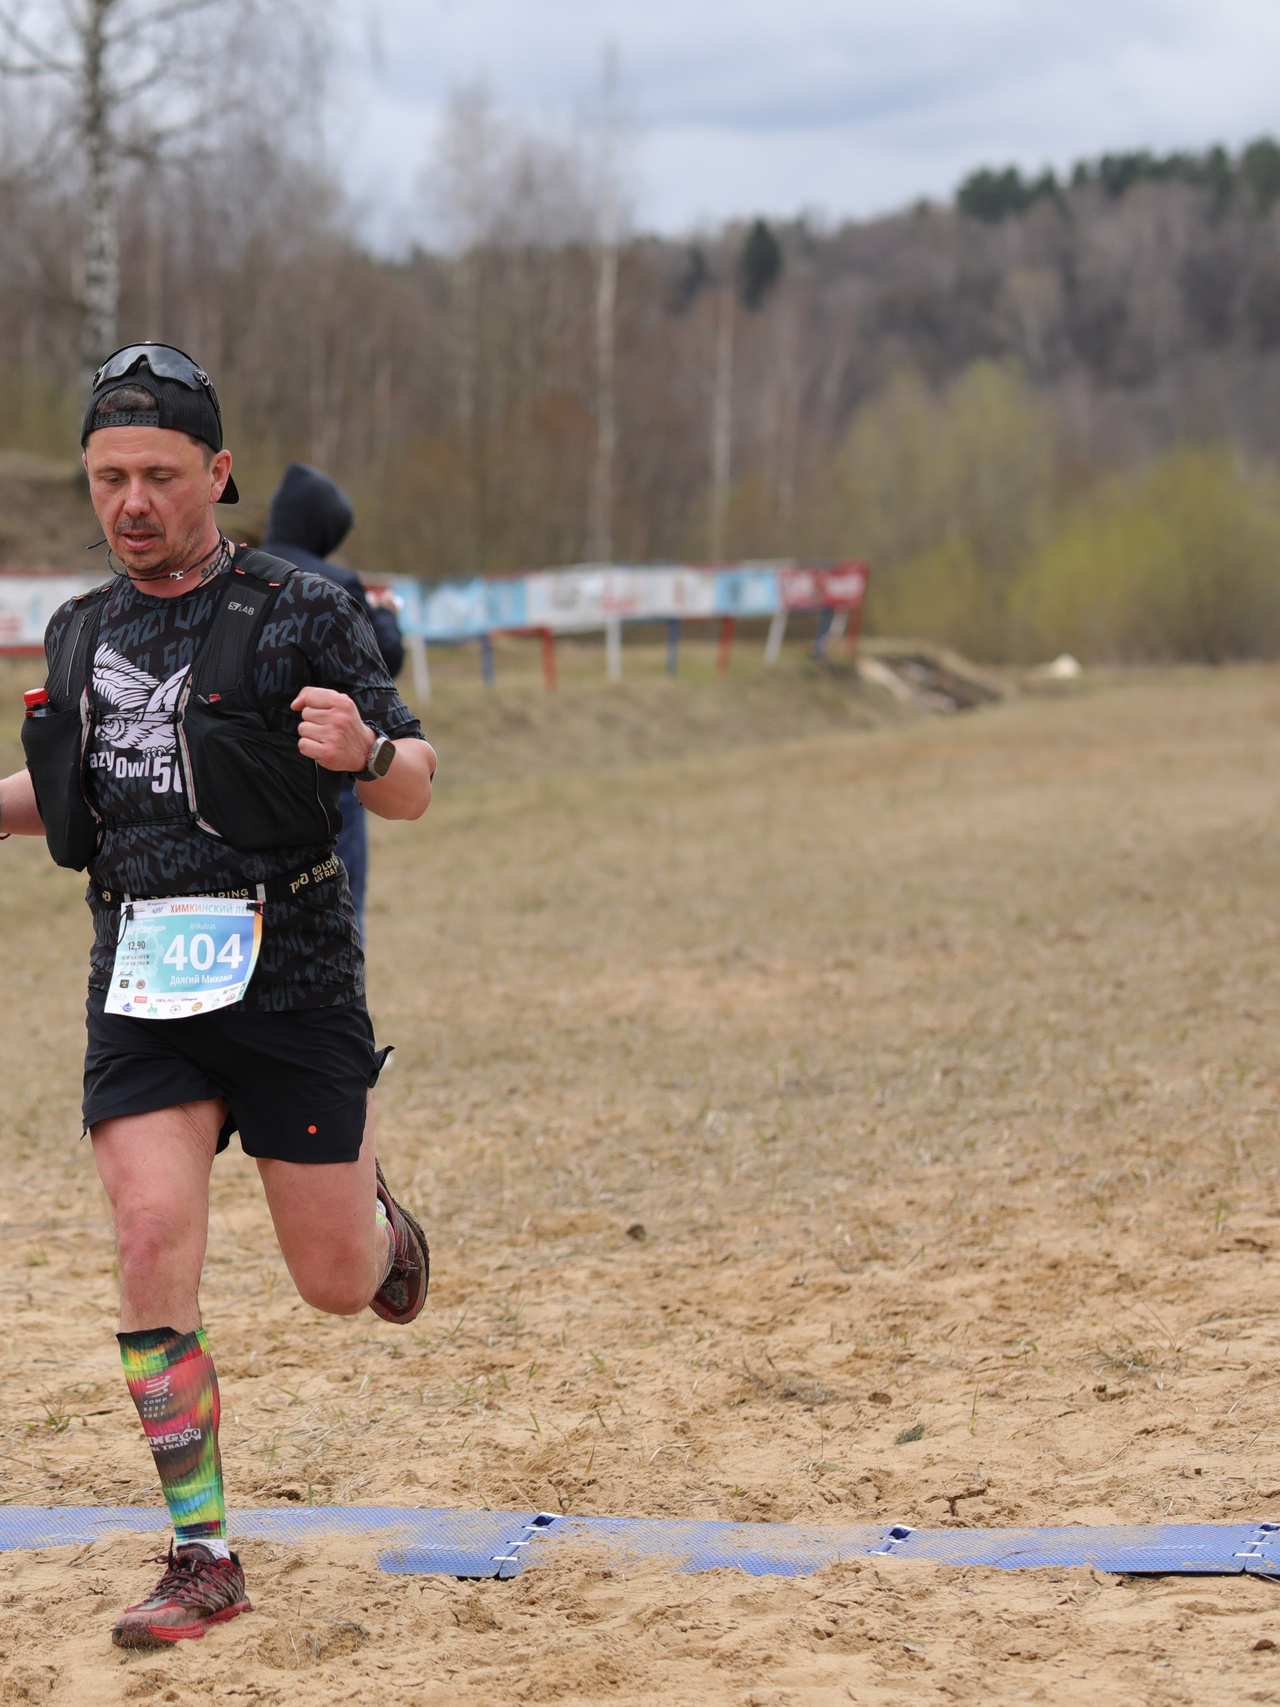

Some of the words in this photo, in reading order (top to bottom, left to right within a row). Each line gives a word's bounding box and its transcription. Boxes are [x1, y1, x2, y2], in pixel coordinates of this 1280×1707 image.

[89, 751, 115, 771] azy
[115, 757, 151, 778] Owl
[170, 903, 233, 913] ХИМКИНСКИЙ
[127, 940, 146, 951] 12,90
[163, 933, 244, 971] 404
[170, 974, 200, 987] Долгий
[201, 974, 233, 984] Михаил
[143, 1397, 168, 1405] COMP
